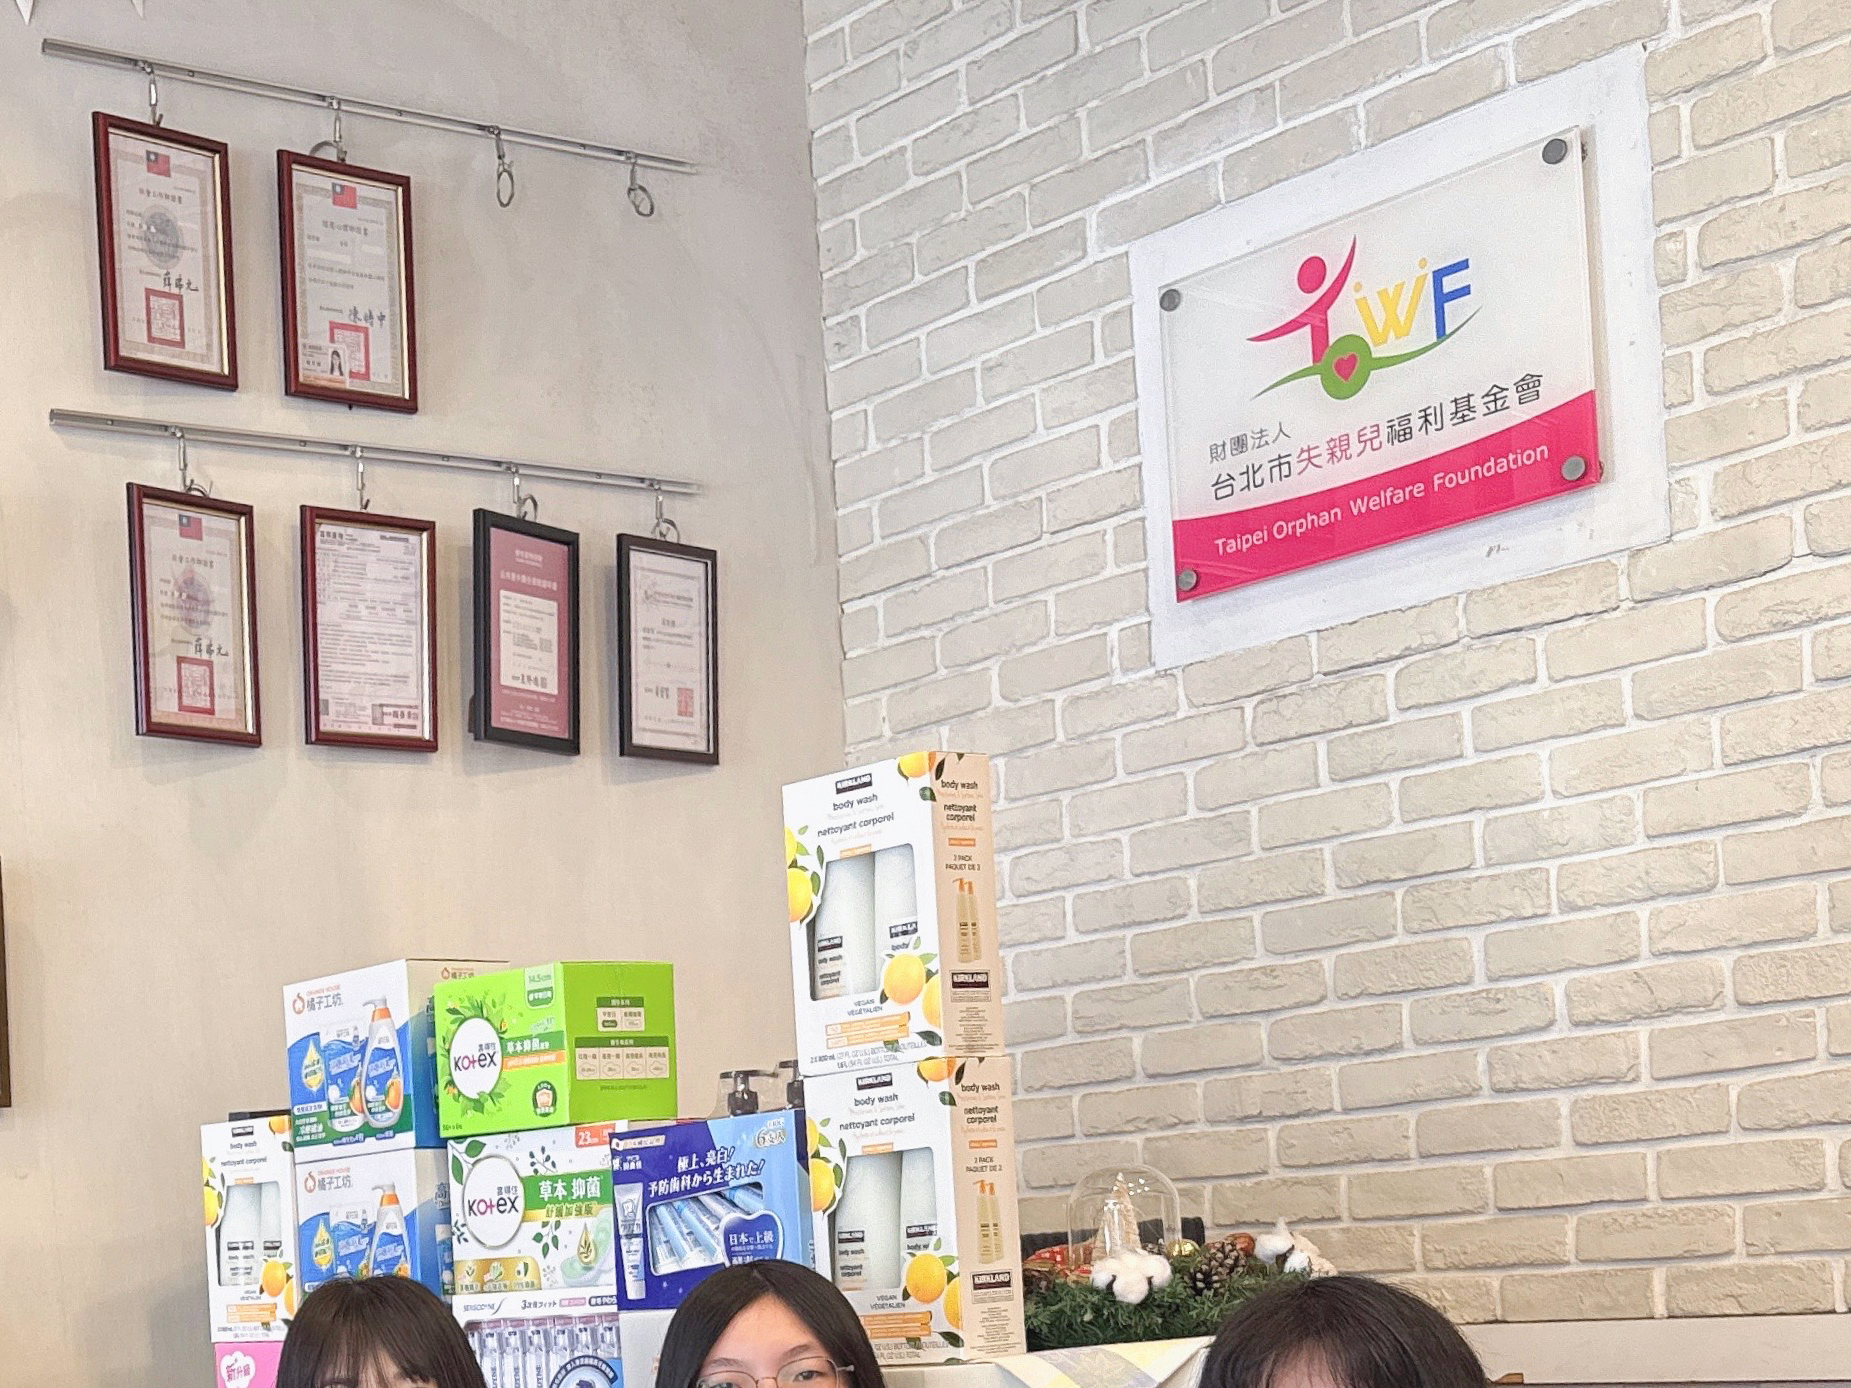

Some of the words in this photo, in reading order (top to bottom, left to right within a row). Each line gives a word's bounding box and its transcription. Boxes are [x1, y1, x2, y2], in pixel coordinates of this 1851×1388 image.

[1209, 421, 1291, 464] 財團法人
[1212, 372, 1544, 501] 台北市失親兒福利基金會
[1214, 515, 1268, 557] Taipei
[1272, 504, 1342, 548] Orphan
[1350, 481, 1425, 517] Welfare
[1432, 446, 1548, 492] Foundation
[941, 779, 960, 791] body
[961, 780, 979, 790] wash
[833, 799, 854, 811] body
[855, 793, 878, 807] wash
[943, 803, 977, 814] nettoyant
[817, 820, 857, 838] nettoyant
[858, 812, 895, 828] corporel
[946, 812, 976, 823] corporel
[306, 993, 343, 1013] 橘子工坊
[961, 1083, 980, 1093] body
[982, 1083, 1000, 1092] wash
[854, 1095, 876, 1107] body
[877, 1093, 899, 1104] wash
[964, 1106, 998, 1116] nettoyant
[966, 1114, 997, 1125] corporel
[839, 1118, 878, 1131] nettoyant
[880, 1113, 915, 1126] corporel
[317, 1175, 352, 1192] 橘子工坊
[539, 1179, 567, 1200] 草本
[571, 1176, 602, 1199] 抑菌
